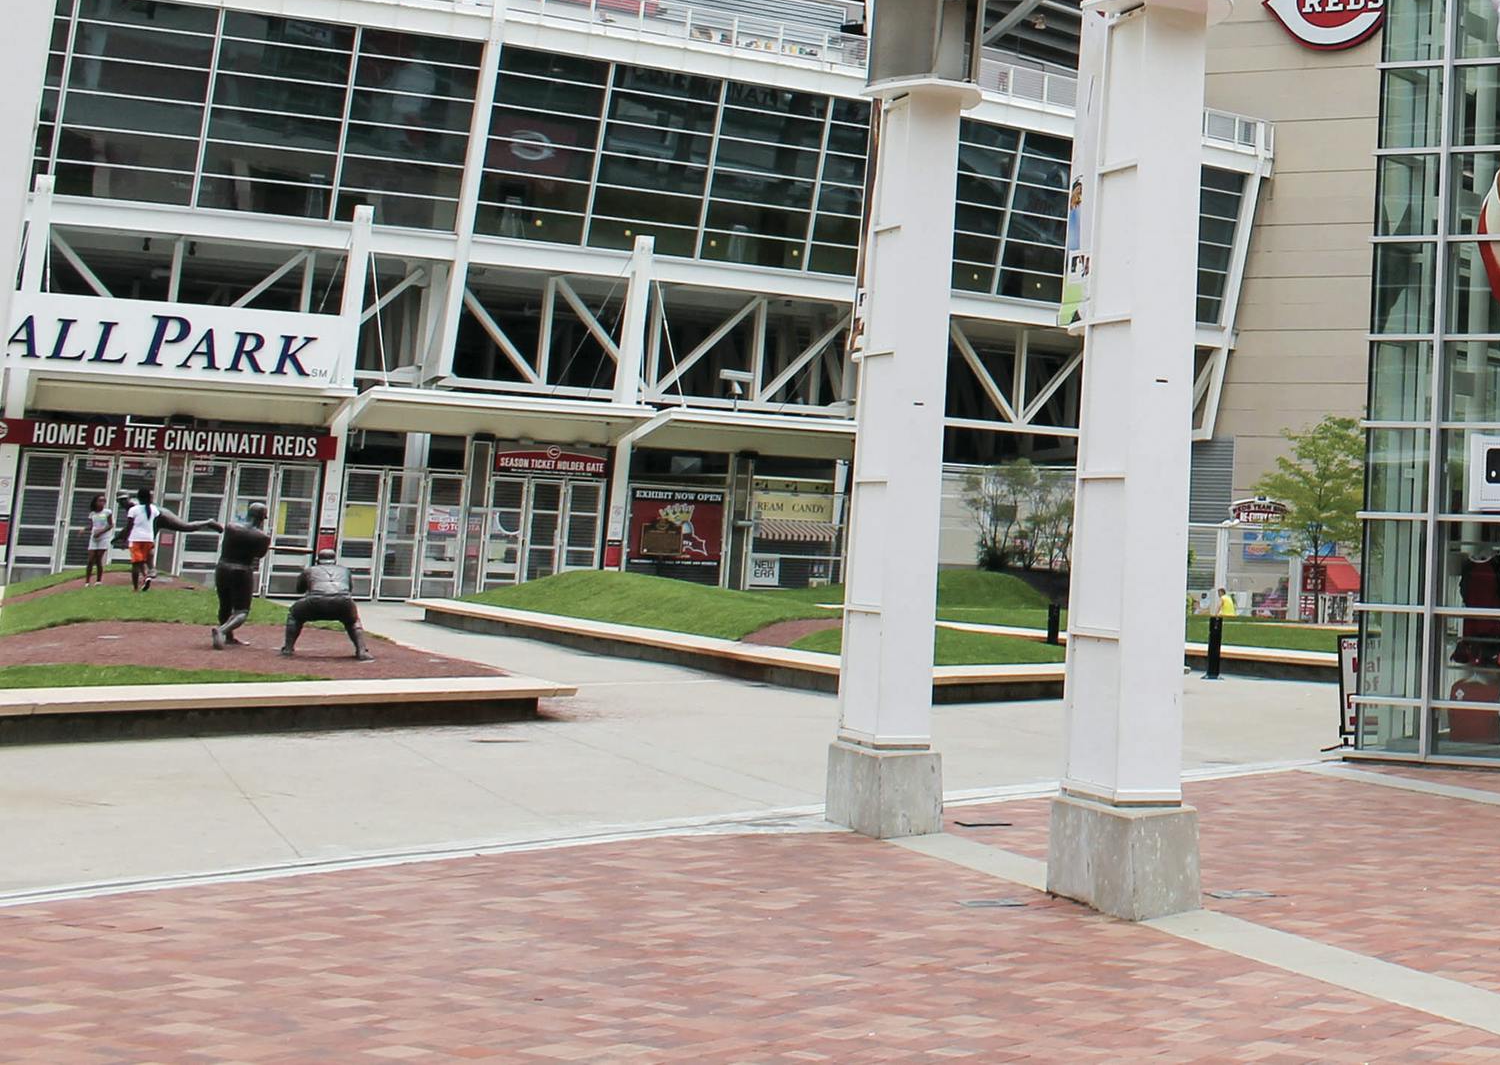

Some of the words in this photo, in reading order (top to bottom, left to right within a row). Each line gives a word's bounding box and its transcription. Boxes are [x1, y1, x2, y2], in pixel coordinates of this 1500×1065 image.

[137, 314, 318, 377] PARK
[32, 422, 87, 445] HOME
[93, 426, 117, 447] OF
[124, 427, 158, 450] THE
[163, 430, 266, 455] CINCINNATI
[273, 436, 318, 457] REDS
[500, 457, 528, 468] SEASON
[531, 459, 556, 470] TICKET
[557, 461, 584, 471] HOLDER
[586, 463, 605, 472] GATE
[636, 490, 672, 500] EXHIBIT
[674, 492, 695, 501] NOW
[697, 493, 722, 502] OPEN
[792, 503, 826, 514] CANDY
[754, 559, 776, 570] NEW
[754, 569, 776, 579] ERA
